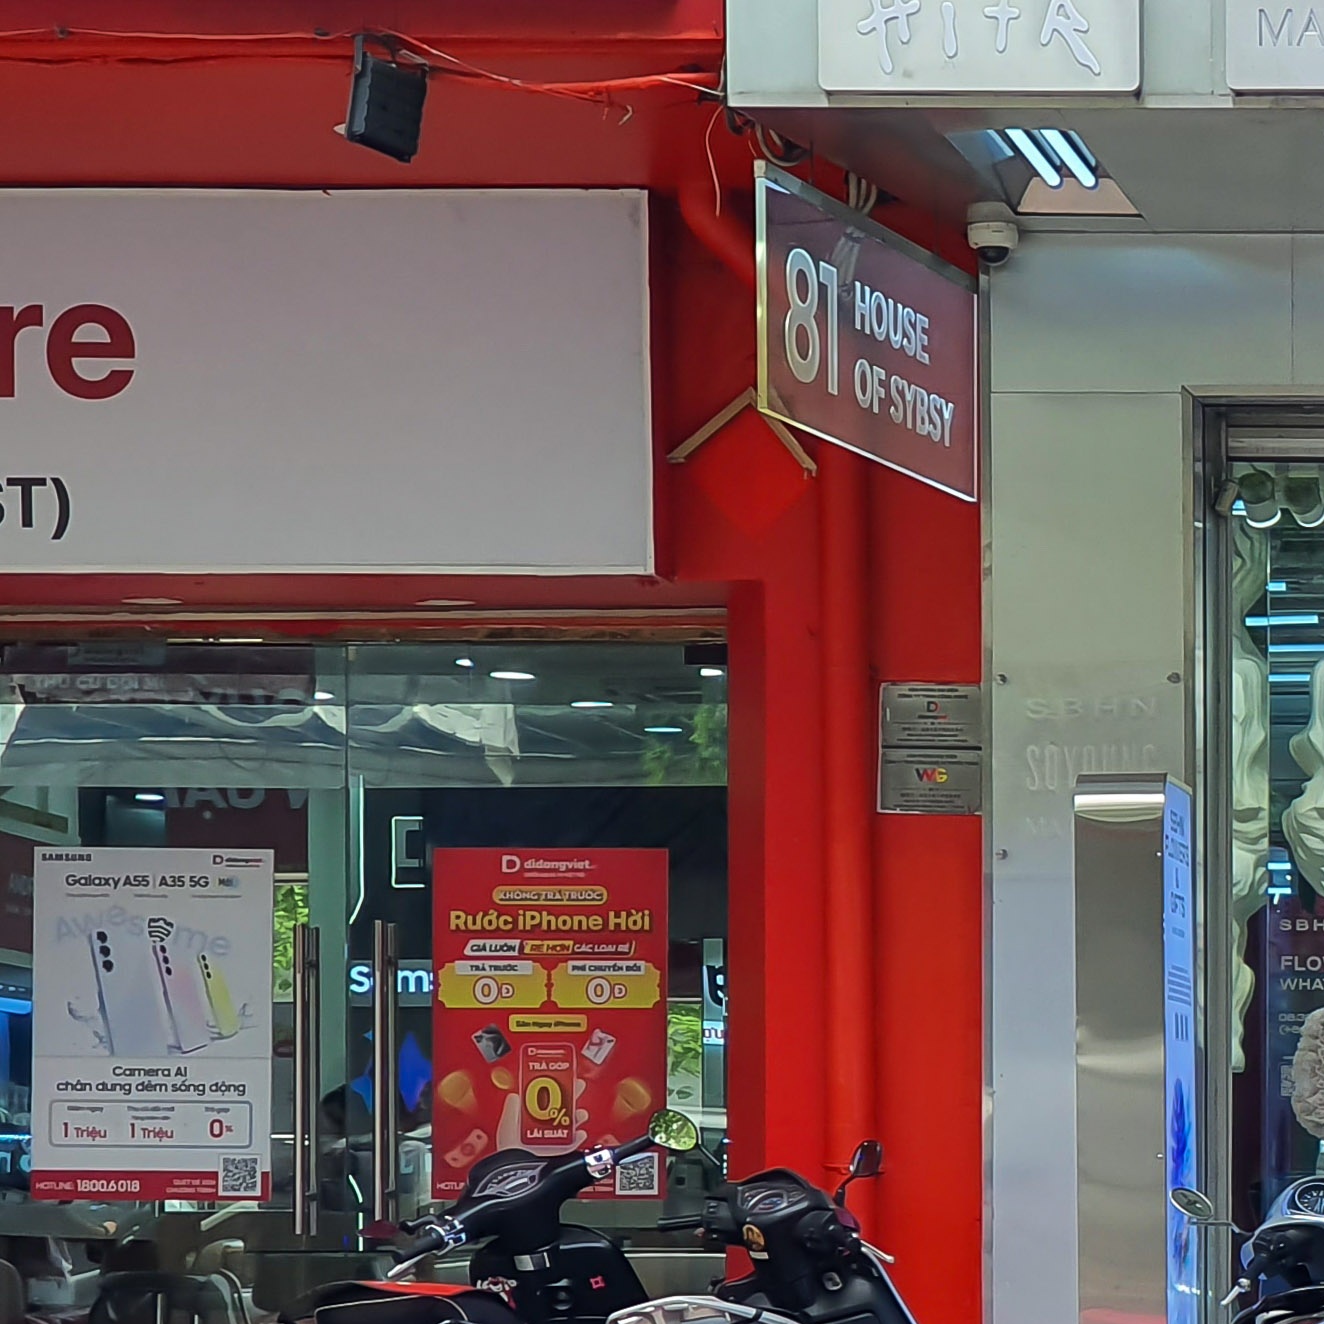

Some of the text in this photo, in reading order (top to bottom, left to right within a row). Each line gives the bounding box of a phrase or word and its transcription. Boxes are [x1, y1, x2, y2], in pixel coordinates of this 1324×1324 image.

[785, 248, 838, 396] 81
[855, 281, 930, 365] HOUSE
[855, 359, 955, 447] OF SYBSY
[0, 477, 70, 540] T)
[65, 874, 121, 889] Galaxy
[122, 875, 150, 887] A55
[158, 875, 185, 887] A35
[189, 875, 209, 888] 5G
[449, 909, 651, 931] Rước iPhone Hời
[112, 1066, 188, 1078] Camera AI
[95, 1080, 132, 1096] dung
[74, 1126, 107, 1142] Triệu
